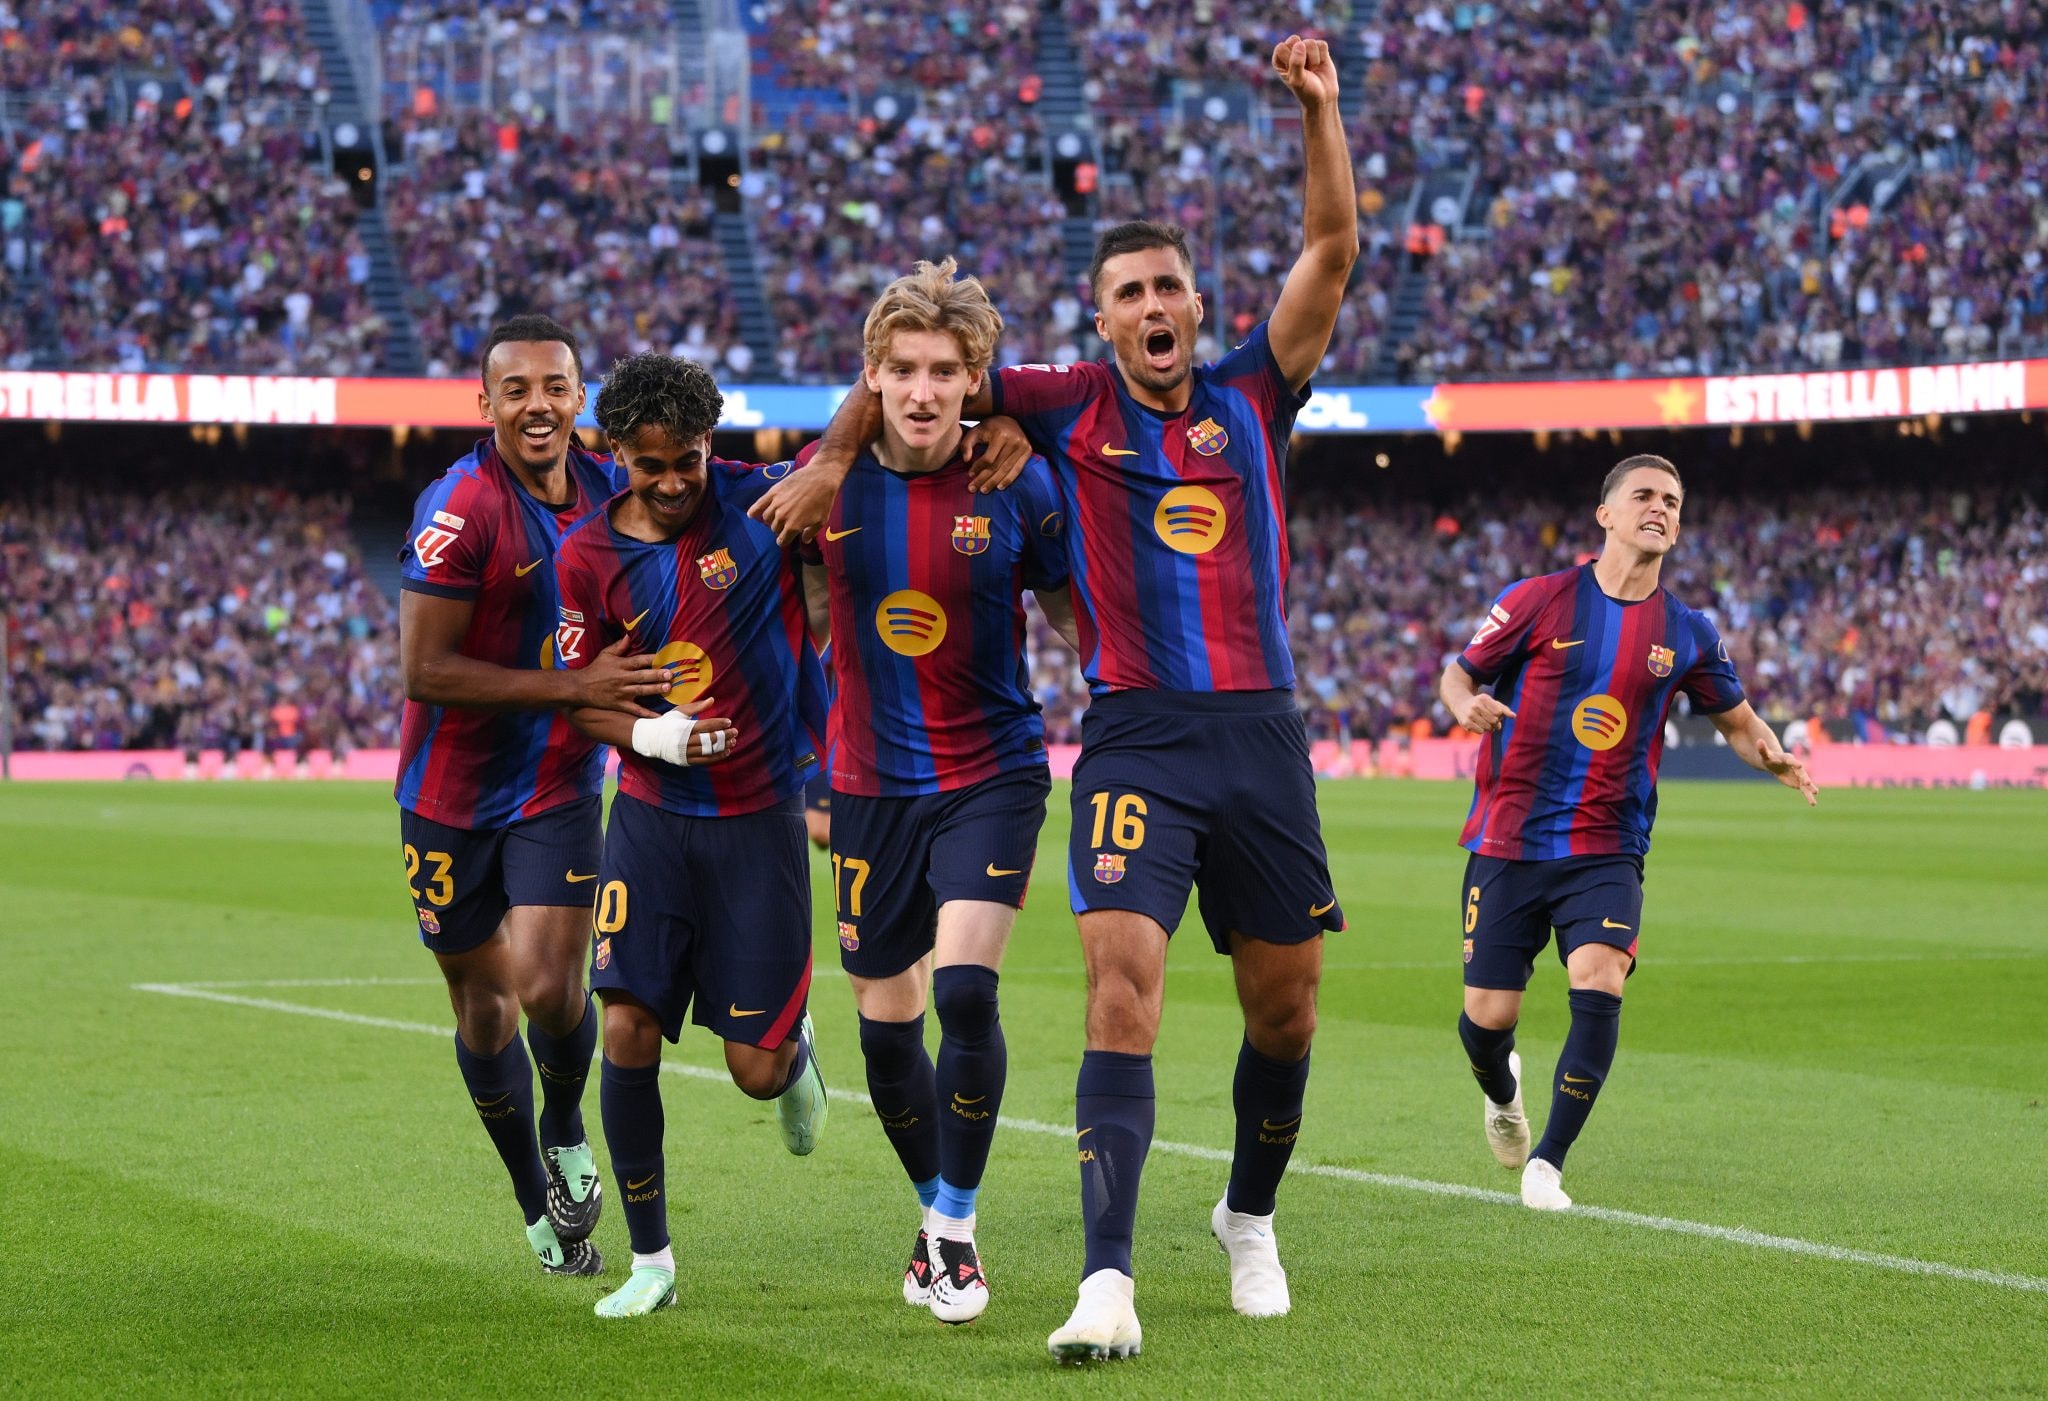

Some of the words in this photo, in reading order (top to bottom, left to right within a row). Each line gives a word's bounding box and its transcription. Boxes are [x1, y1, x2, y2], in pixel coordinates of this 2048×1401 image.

[1705, 369, 1900, 423] ESTRELLA
[1091, 792, 1148, 850] 16
[404, 843, 454, 906] 23
[832, 853, 872, 917] 17
[1465, 886, 1480, 934] 6
[951, 1102, 989, 1121] BARÇA
[1559, 1083, 1589, 1101] BARÇA
[1259, 1132, 1299, 1145] BARÇA
[627, 1188, 659, 1203] BARÇA
